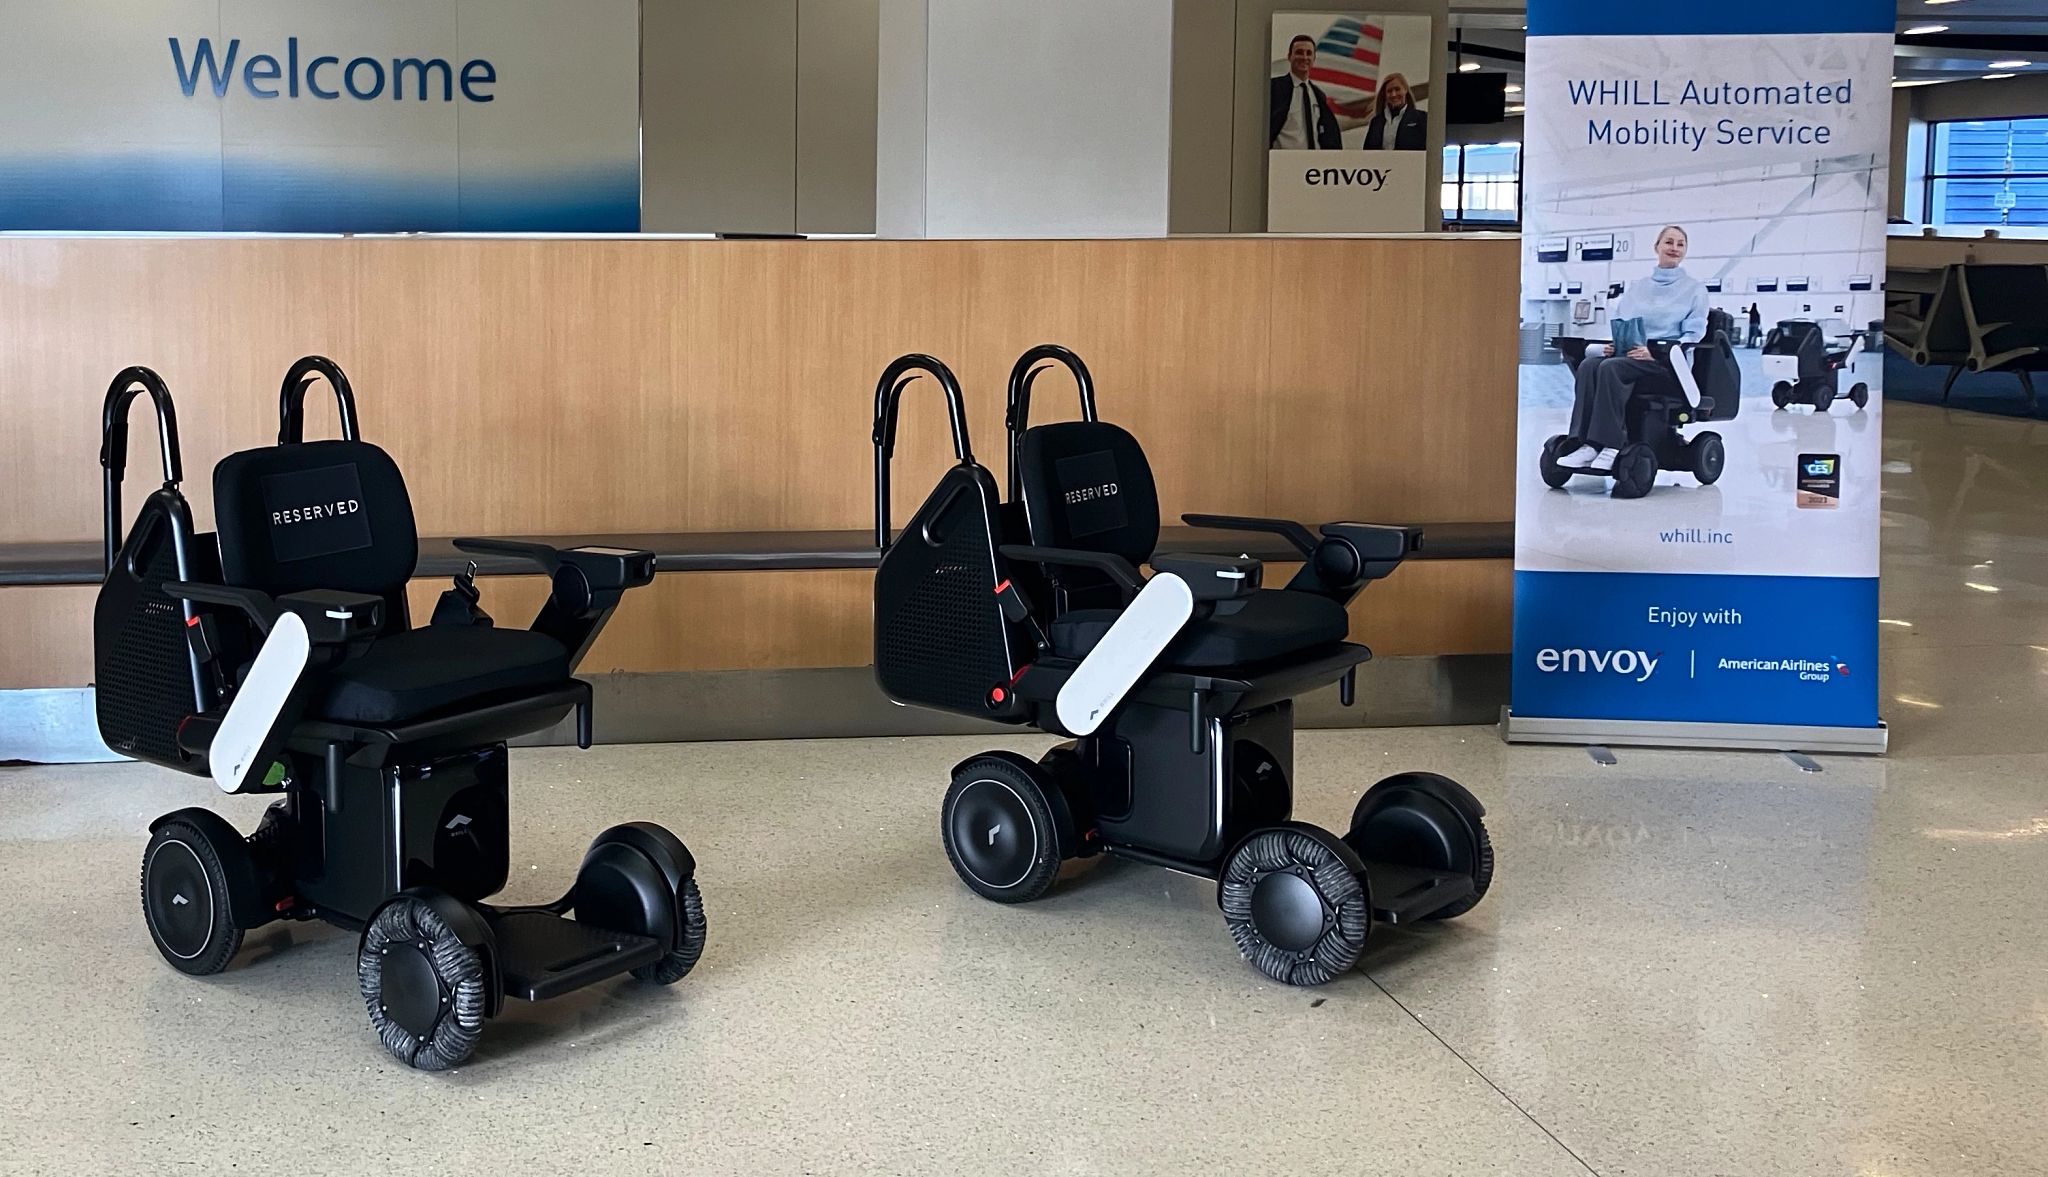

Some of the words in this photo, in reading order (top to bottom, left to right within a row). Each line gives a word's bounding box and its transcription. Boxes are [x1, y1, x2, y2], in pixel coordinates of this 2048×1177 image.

[168, 37, 496, 103] Welcome
[1568, 80, 1670, 105] WHILL
[1679, 79, 1852, 105] Automated
[1588, 119, 1706, 151] Mobility
[1716, 119, 1831, 145] Service
[1305, 168, 1392, 191] envoy
[1616, 240, 1629, 253] 20
[1807, 464, 1829, 474] CES
[1065, 483, 1118, 504] RESERVED
[272, 499, 359, 525] RESERVED
[1659, 528, 1733, 544] whill.inc
[1648, 606, 1698, 627] Enjoy
[1702, 608, 1742, 625] with
[1536, 648, 1660, 682] envoy
[1718, 658, 1779, 671] American
[1780, 659, 1830, 673] Airlines
[1800, 671, 1830, 683] Group
